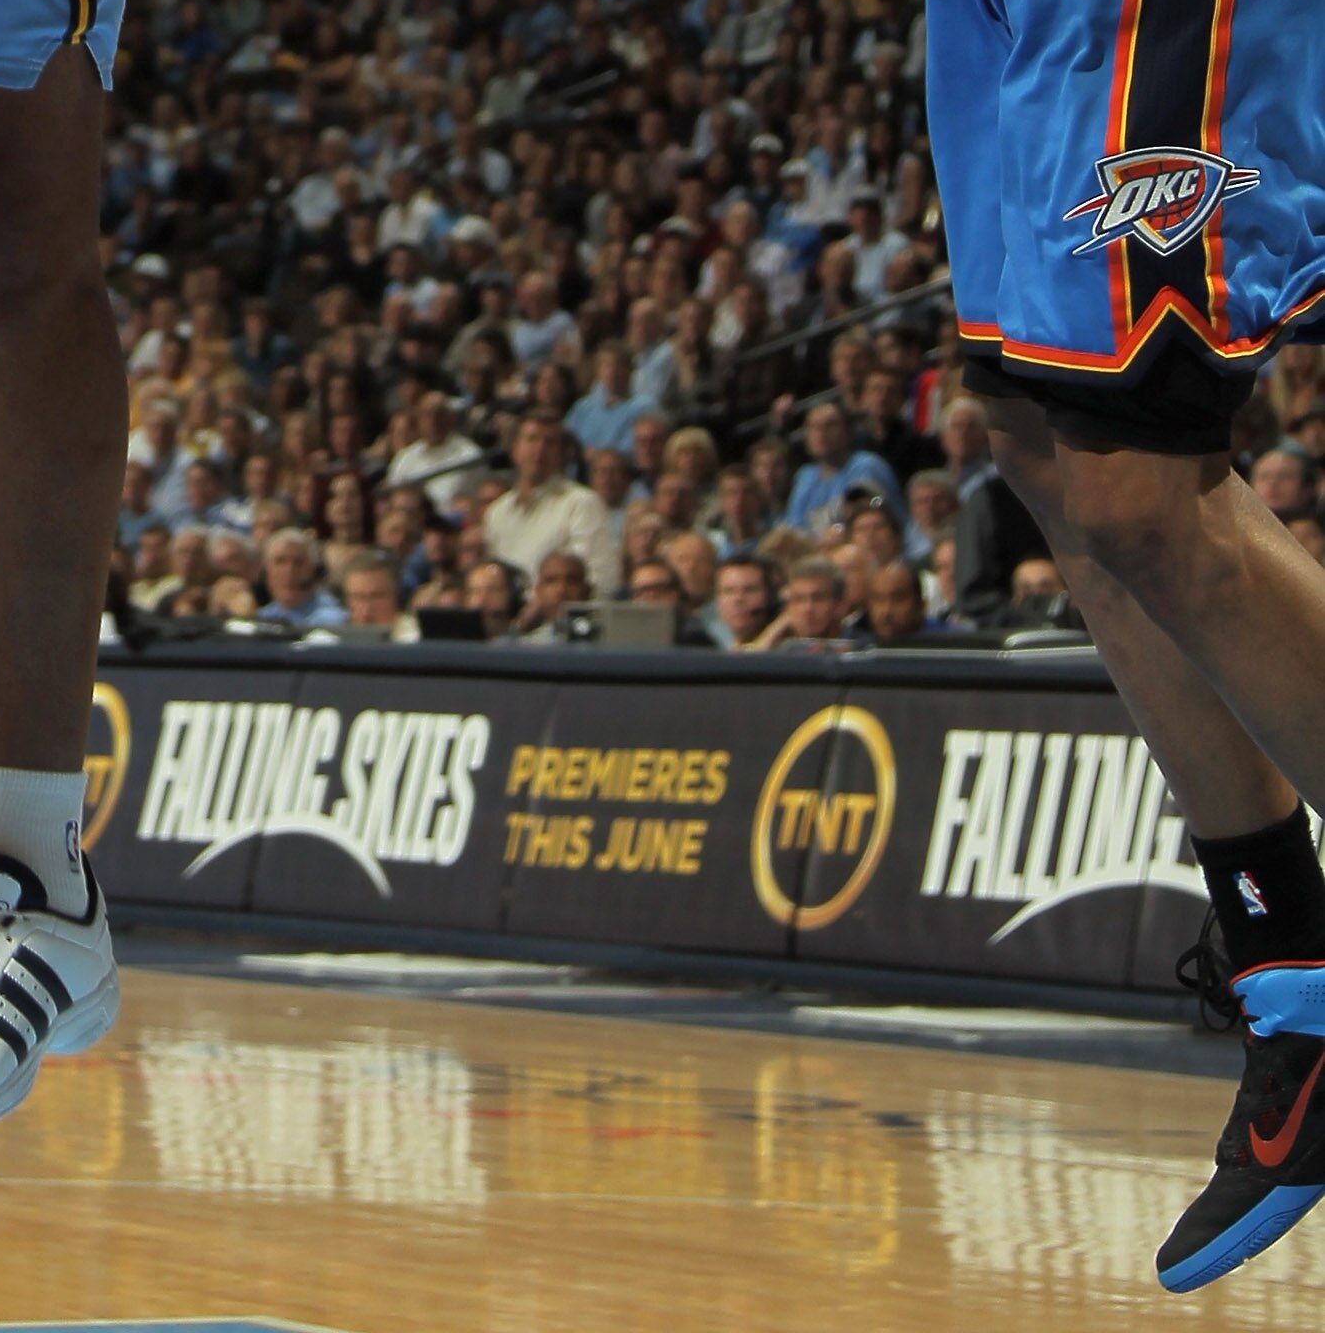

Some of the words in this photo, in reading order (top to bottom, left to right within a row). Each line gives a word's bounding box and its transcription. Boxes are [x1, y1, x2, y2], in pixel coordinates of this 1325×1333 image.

[1102, 168, 1201, 231] OKC
[136, 700, 341, 841] FALLING
[331, 709, 490, 866] SKIES
[505, 744, 732, 805] PREMIERES
[503, 811, 595, 870] THIS
[594, 816, 710, 875] JUNE
[776, 788, 877, 855] TNT
